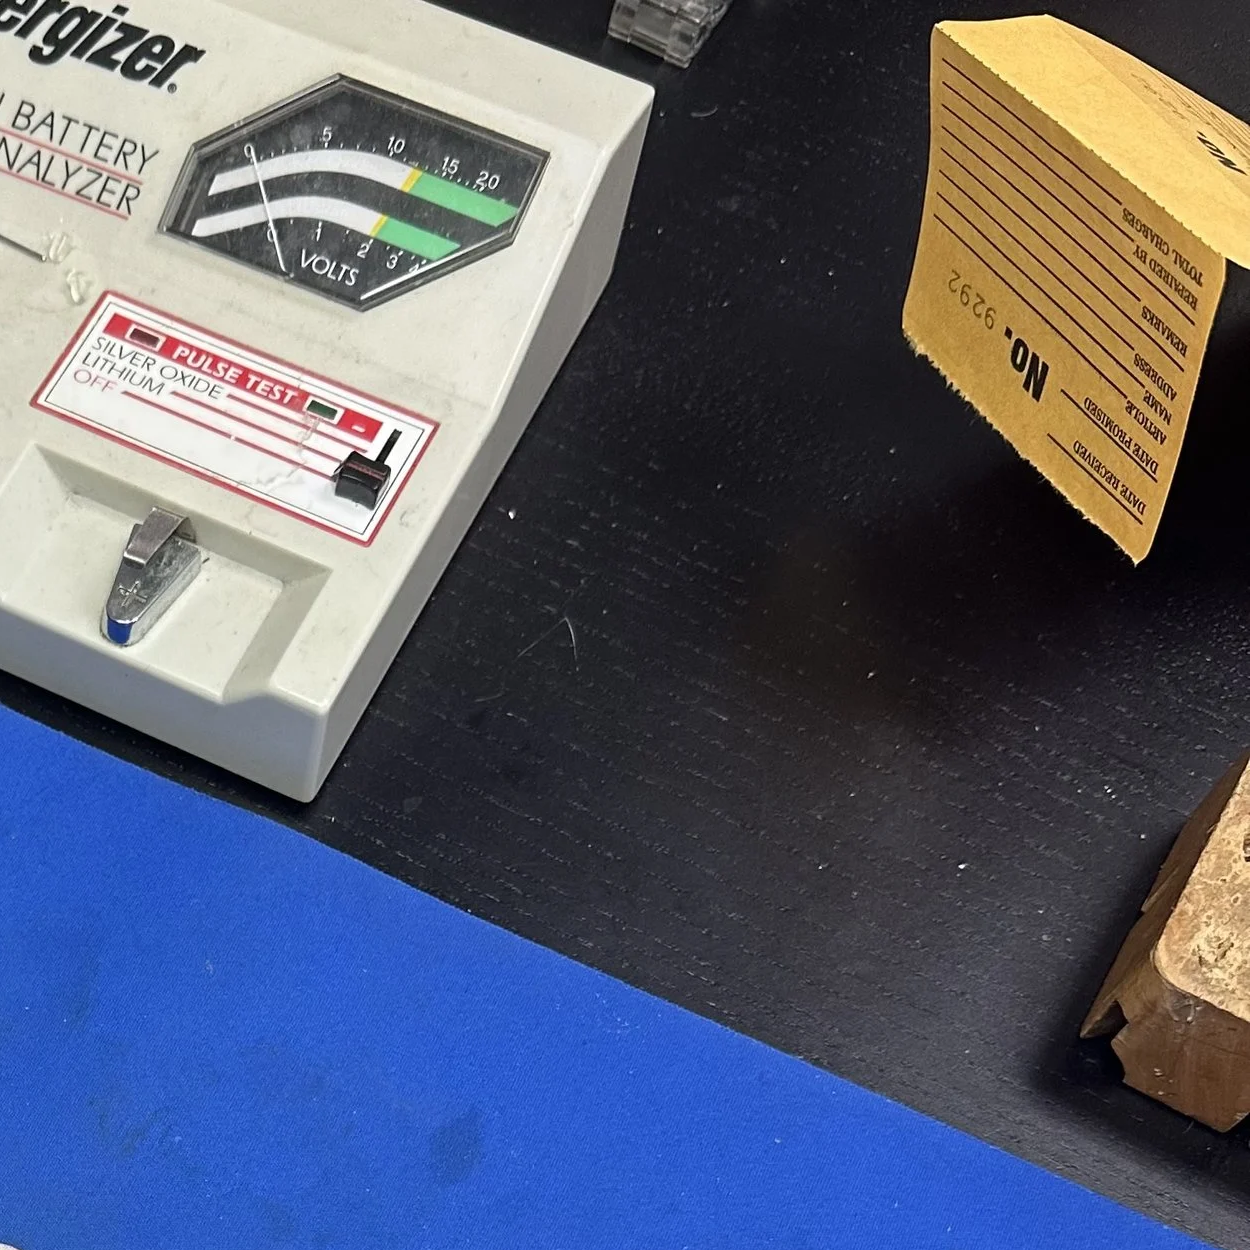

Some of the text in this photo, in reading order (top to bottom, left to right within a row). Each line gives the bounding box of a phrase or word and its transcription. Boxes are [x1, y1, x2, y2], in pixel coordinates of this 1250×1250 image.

[11, 99, 160, 176] BATTERY
[321, 126, 500, 190] 5 10 15 20
[300, 249, 360, 287] VOLTS
[1122, 208, 1203, 287] TOTAL CHARGES
[1133, 244, 1199, 311] REPAIRED BY
[947, 269, 1050, 403] No. 9292
[1141, 305, 1188, 358] REMARKS
[72, 368, 119, 393] OFF
[81, 352, 165, 397] LITHIUM
[91, 336, 226, 400] SILVER OXIDE
[171, 344, 299, 406] PULSE TEST
[1133, 353, 1177, 402] ADDRESS
[1083, 397, 1159, 475] DATE PROMISED
[1125, 400, 1167, 446] ARTICLE
[1142, 389, 1173, 426] NAME
[1073, 440, 1147, 516] DATE RECEIVED
